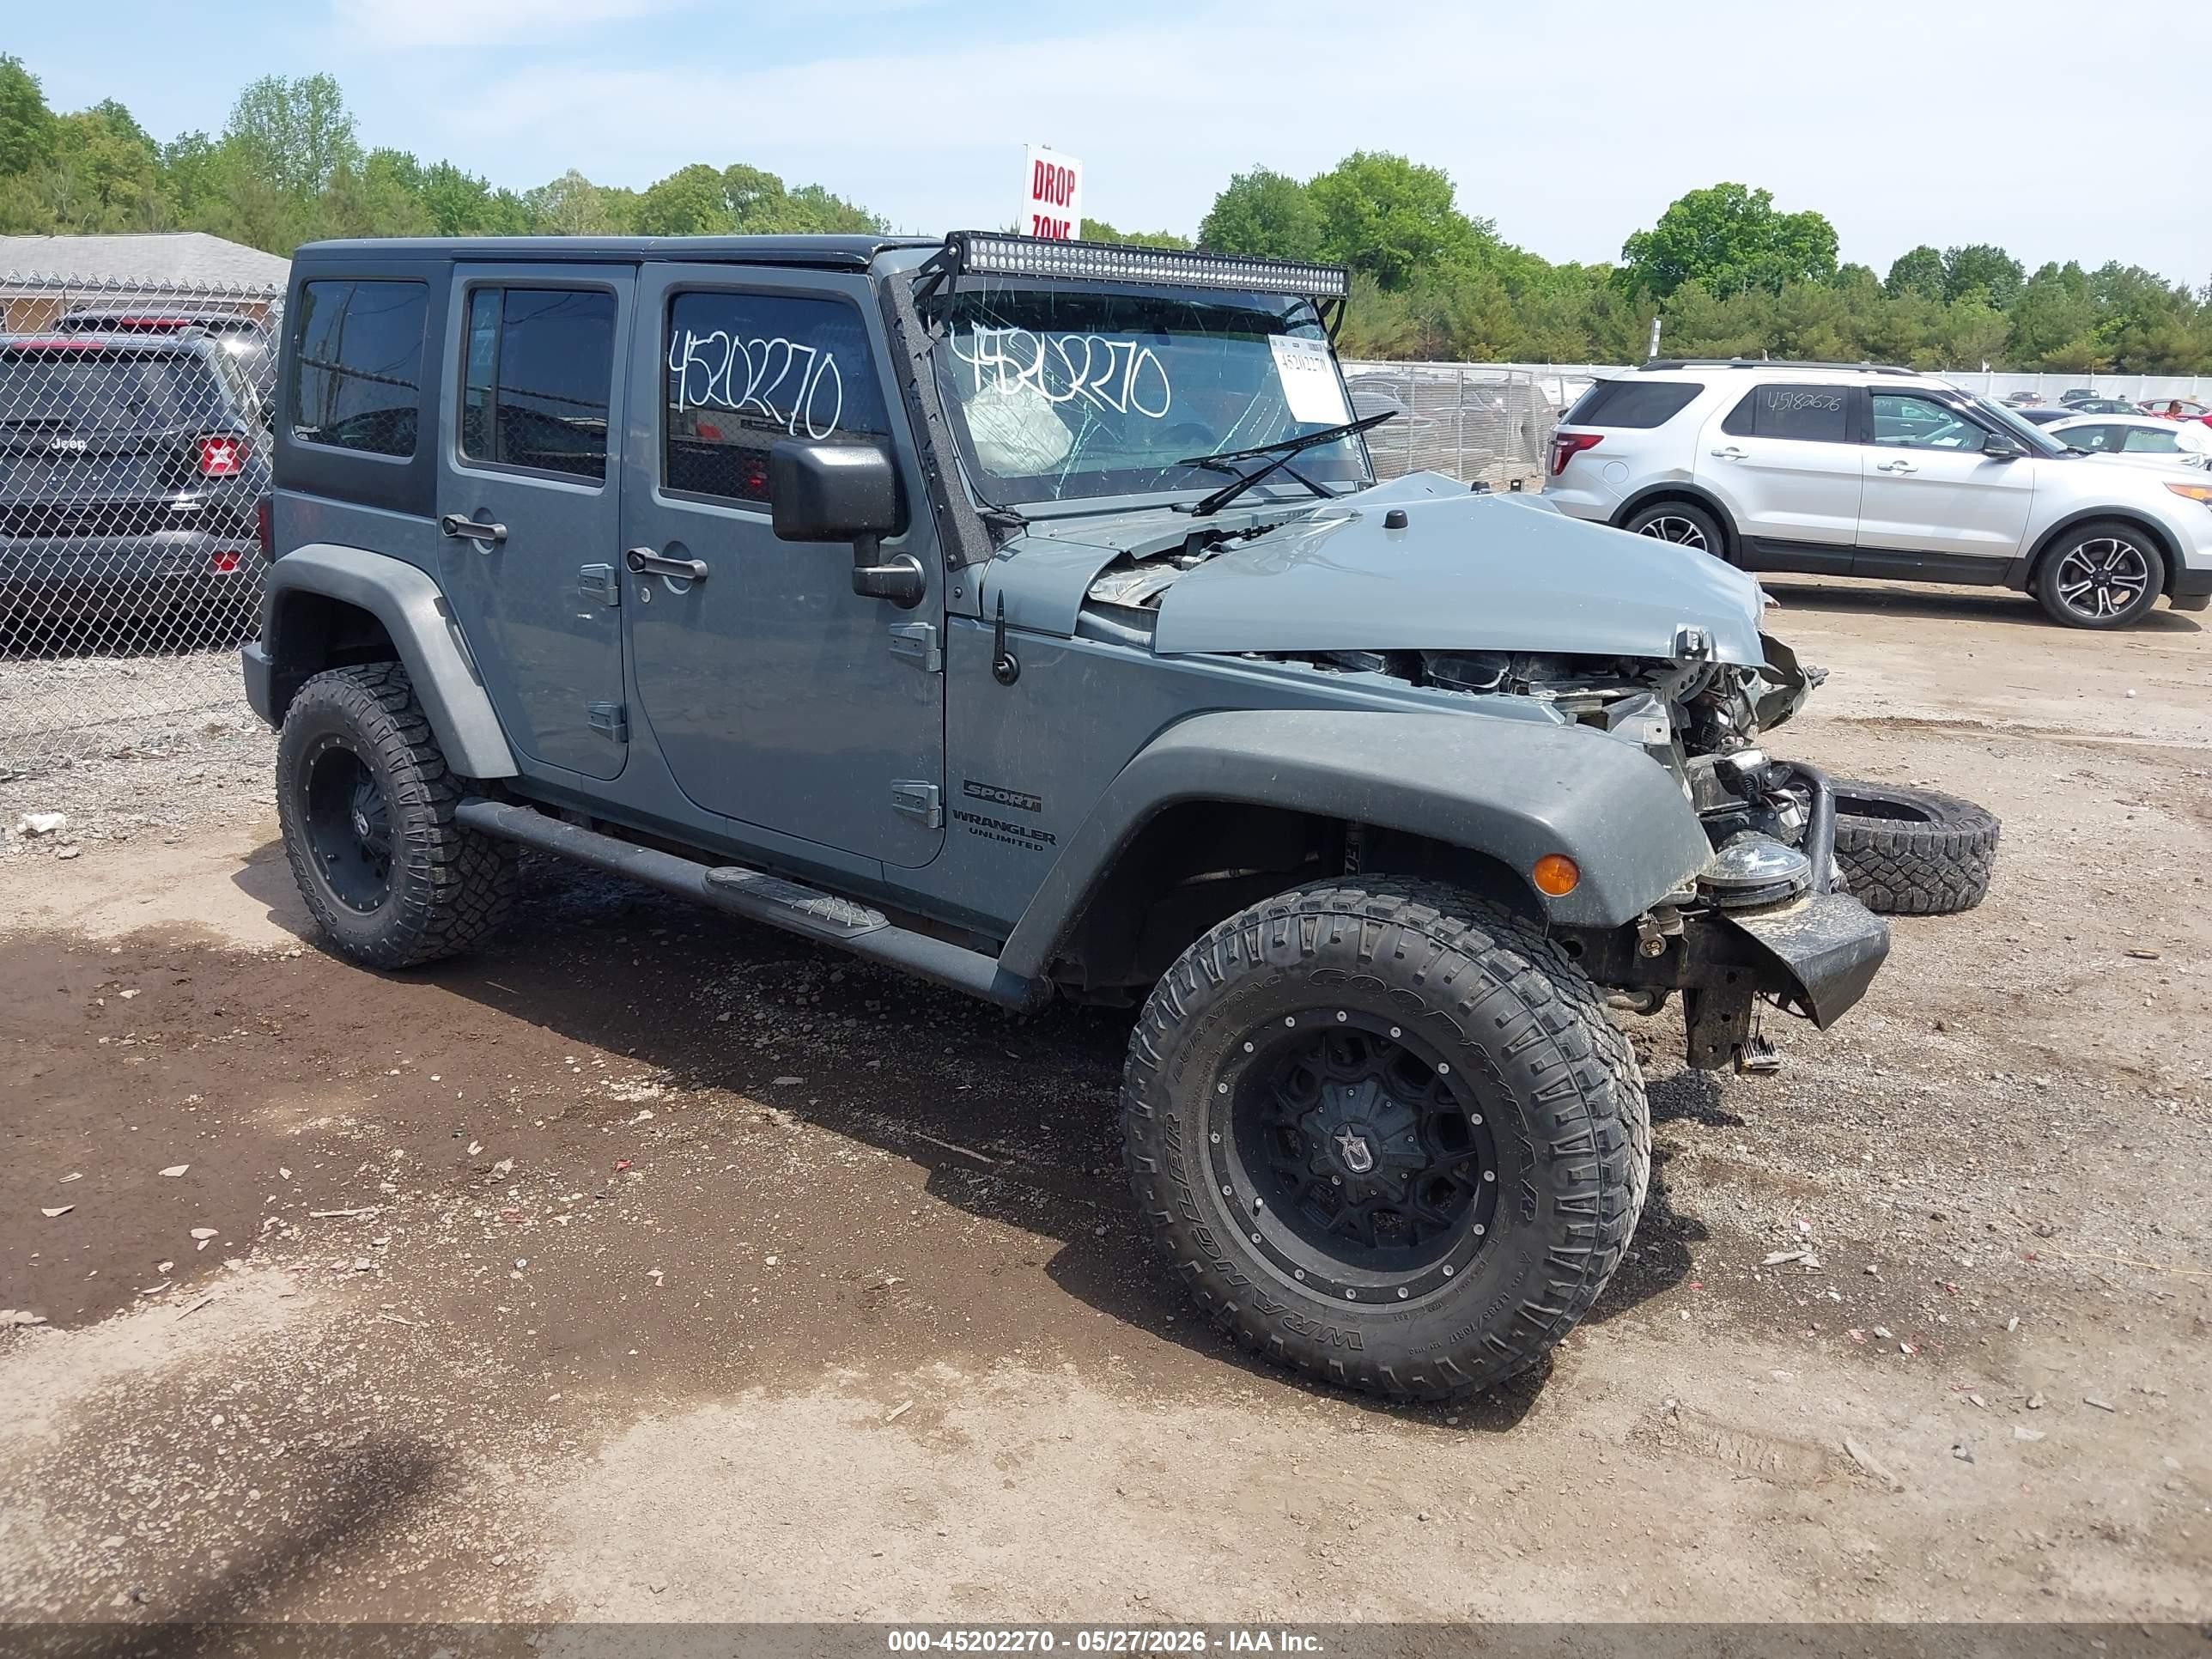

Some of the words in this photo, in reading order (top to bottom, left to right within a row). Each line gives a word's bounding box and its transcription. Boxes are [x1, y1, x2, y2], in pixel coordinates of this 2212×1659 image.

[1032, 160, 1075, 208] DROP
[1282, 354, 1328, 374] 45202270
[668, 328, 843, 441] 45202270
[52, 437, 88, 451] Jeep
[964, 783, 1042, 809] SPORT
[952, 809, 1059, 847] WRANGLER
[969, 827, 1044, 852] UNLIMITED
[1307, 968, 1540, 1222] GOODYEAR
[1164, 1112, 1364, 1352] WRANGLER
